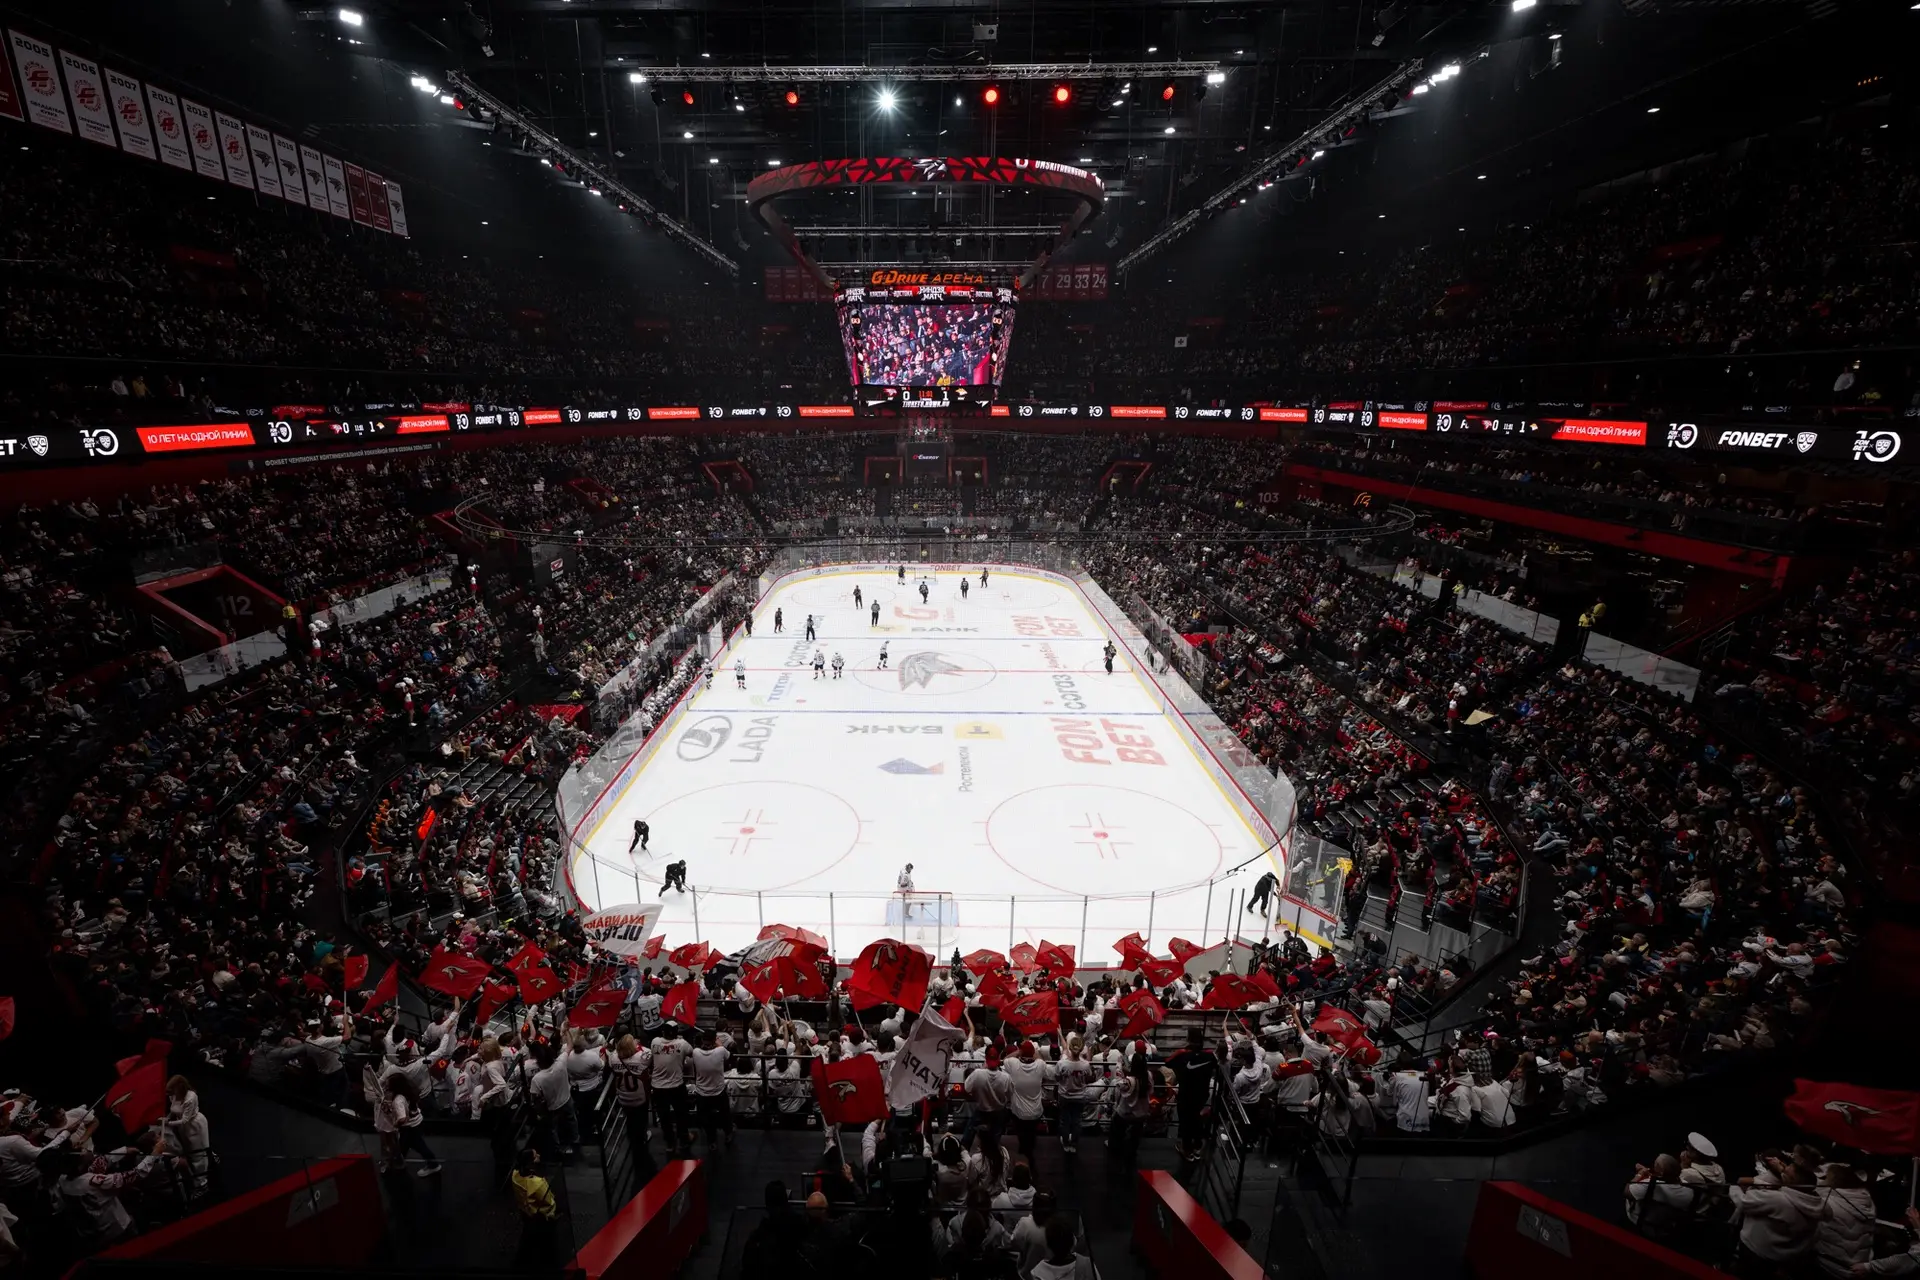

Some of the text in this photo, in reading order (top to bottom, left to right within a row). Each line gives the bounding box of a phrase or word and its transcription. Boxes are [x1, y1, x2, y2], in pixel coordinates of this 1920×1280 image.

[15, 37, 49, 57] 2005
[65, 56, 96, 76] 2006
[110, 75, 136, 91] 2007
[152, 91, 174, 106] 2011
[186, 104, 208, 118] 2012
[220, 117, 239, 130] 2012
[932, 273, 984, 283] АРЕНА
[1057, 275, 1071, 288] 29
[1075, 274, 1089, 289] 33
[1092, 274, 1106, 288] 24
[918, 285, 947, 295] НИНДЗЯ
[921, 293, 944, 301] МАТЧ
[902, 391, 911, 400] 0
[943, 391, 948, 400] 1
[732, 408, 757, 416] FONBET
[1196, 409, 1221, 417] FONBET
[343, 421, 349, 434] 0
[370, 421, 375, 432] 1
[1492, 419, 1499, 430] 0
[1519, 421, 1525, 433] 1
[147, 430, 248, 444] 10 ЛЕТ НА ОДНОЙ ЛИНИИ
[1562, 426, 1576, 434] ЛЕТ
[1587, 426, 1613, 436] ОДНОЙ
[1614, 428, 1641, 438] ЛИНИИ
[80, 429, 118, 456] 10
[1718, 431, 1788, 448] FONBET
[1853, 431, 1901, 462] 10
[1258, 492, 1279, 503] 103
[217, 595, 254, 616] 112
[846, 725, 943, 735] БАНК
[730, 715, 779, 762] LADA
[1049, 717, 1112, 765] FON
[1100, 718, 1168, 766] BET
[641, 1007, 660, 1024] 35
